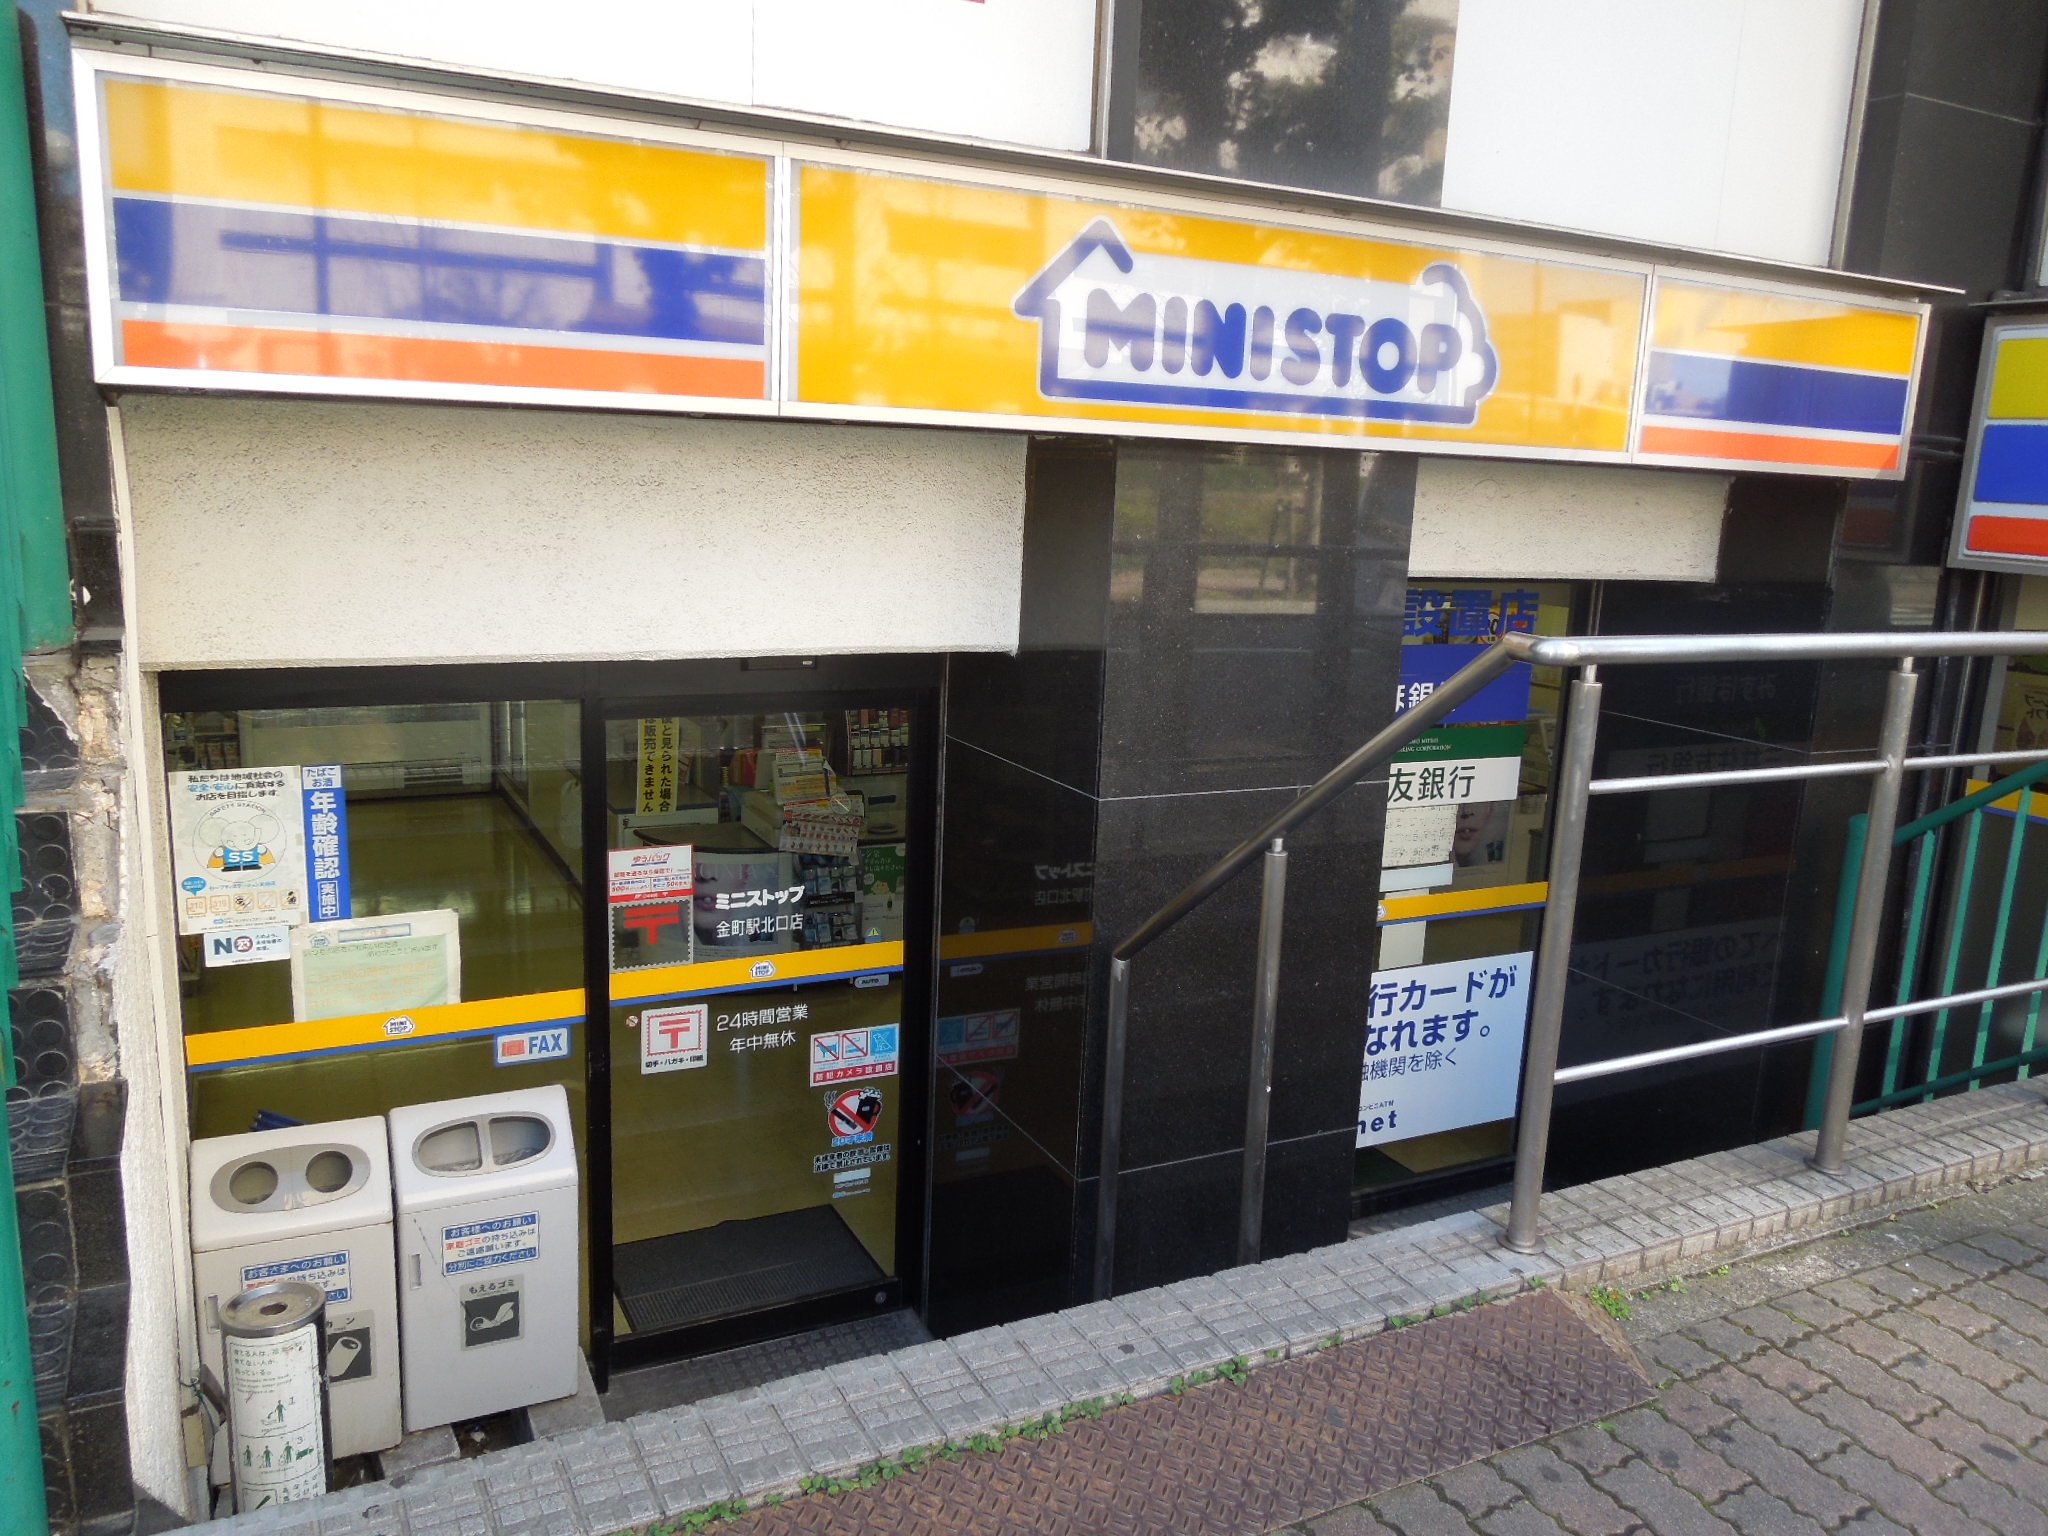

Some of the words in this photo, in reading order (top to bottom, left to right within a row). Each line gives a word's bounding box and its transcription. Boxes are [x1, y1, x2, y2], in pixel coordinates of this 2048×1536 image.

[1084, 287, 1463, 395] MINISTOP
[1403, 588, 1540, 636] 設置店
[187, 770, 283, 783] 私たちは地域社会の
[306, 768, 336, 778] たばこ
[311, 777, 333, 787] お酒
[1387, 766, 1476, 803] 友銀行
[310, 791, 341, 880] 年齢確認
[228, 851, 255, 863] SS
[320, 883, 337, 918] 実施中
[715, 885, 806, 910] ミニストップ
[715, 913, 804, 938] 金町駅北口店
[1368, 965, 1518, 1019] 行カードが
[389, 1025, 408, 1033] STOP
[716, 1003, 809, 1032] 24時間営業
[528, 1033, 563, 1055] FAX
[729, 1029, 797, 1054] 年中無休
[1366, 1009, 1491, 1056] なれます。
[645, 1055, 704, 1069] 切手・ハガキ・印紙
[815, 1062, 894, 1081] 防犯カメラ設置店
[450, 1216, 532, 1238] お客様へのお願い
[446, 1228, 536, 1251] 家庭ゴミの持ち込みは
[457, 1239, 527, 1258] ご遠慮願います。
[247, 1254, 345, 1279] お客さまへのお願い
[447, 1249, 535, 1272] 分別にご協力ください
[469, 1279, 514, 1294] もえるゴミ
